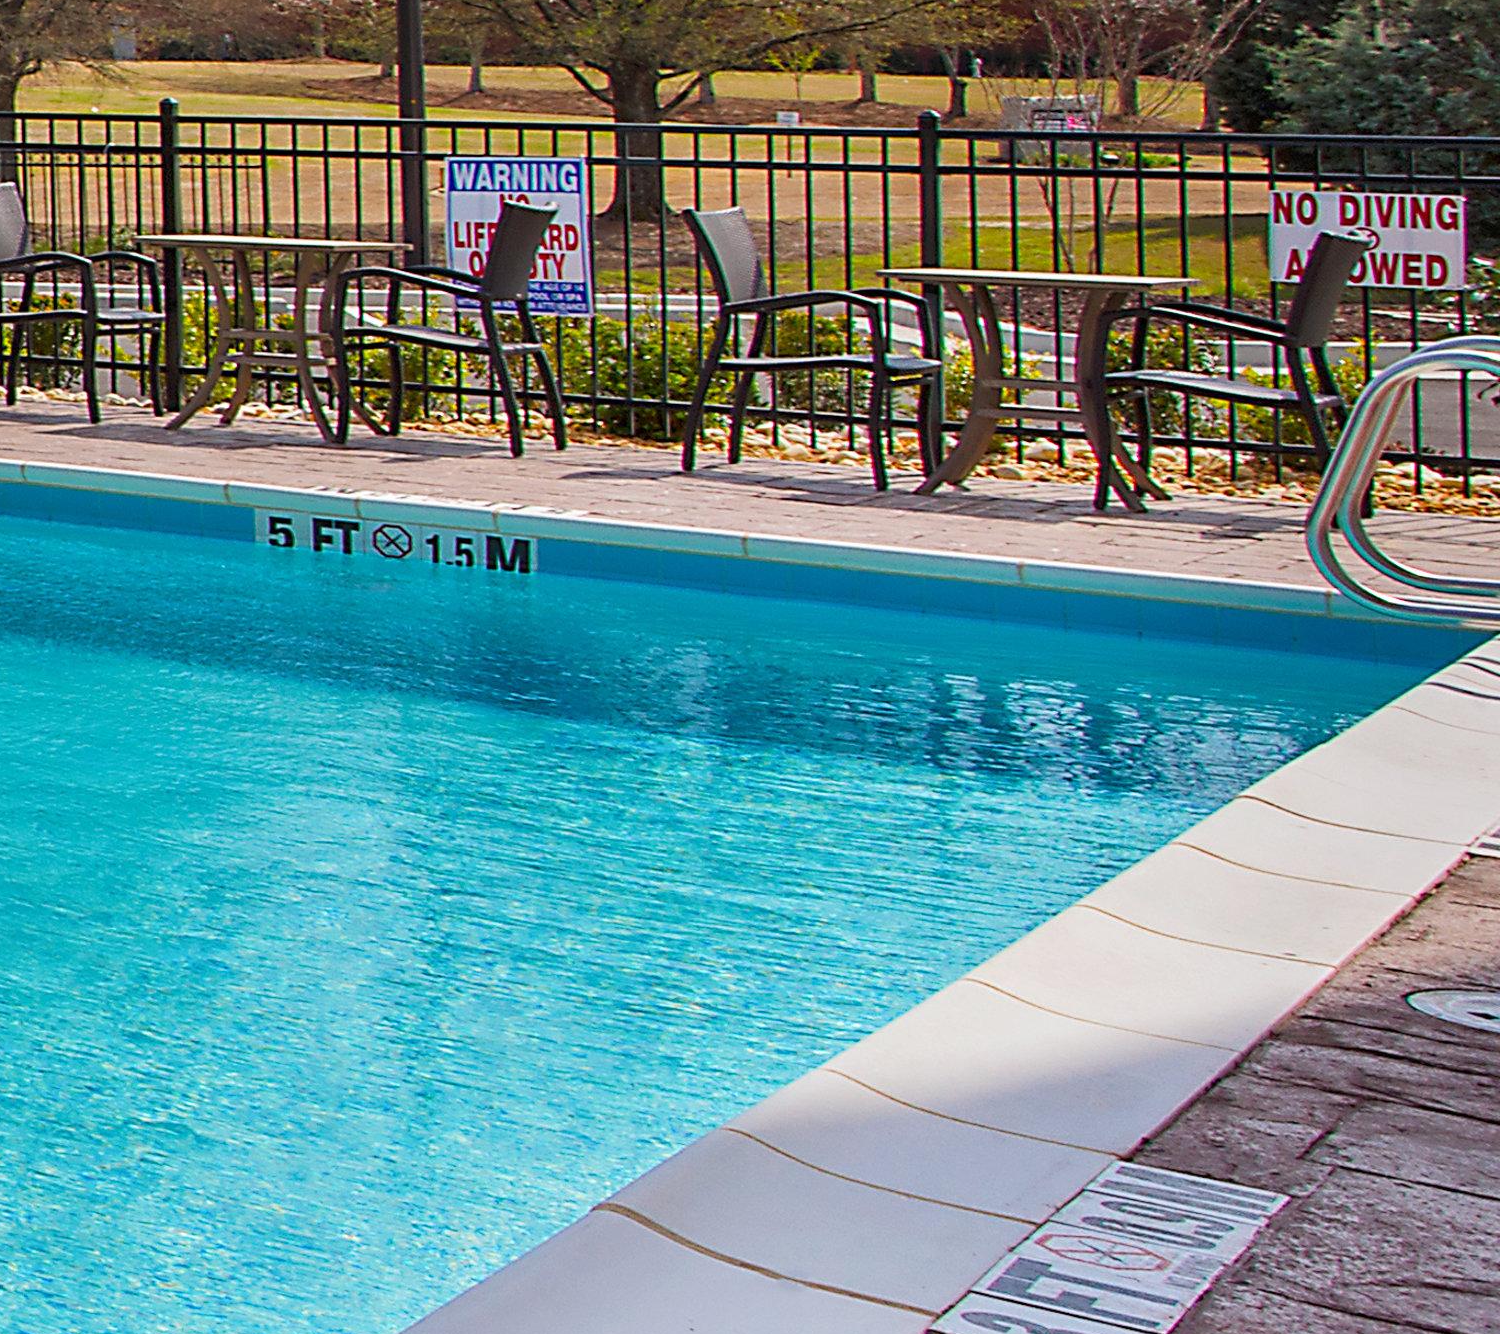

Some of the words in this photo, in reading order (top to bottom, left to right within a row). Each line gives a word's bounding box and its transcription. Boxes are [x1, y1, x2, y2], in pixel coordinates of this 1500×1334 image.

[453, 163, 579, 191] WARNING
[1273, 192, 1318, 225] NO
[1339, 195, 1459, 230] DIVING
[1285, 248, 1448, 287] AOWED
[268, 516, 296, 548] 5
[311, 517, 360, 555] FT
[485, 535, 532, 574] M
[986, 1256, 1181, 1330] FT
[1100, 1165, 1285, 1221] M
